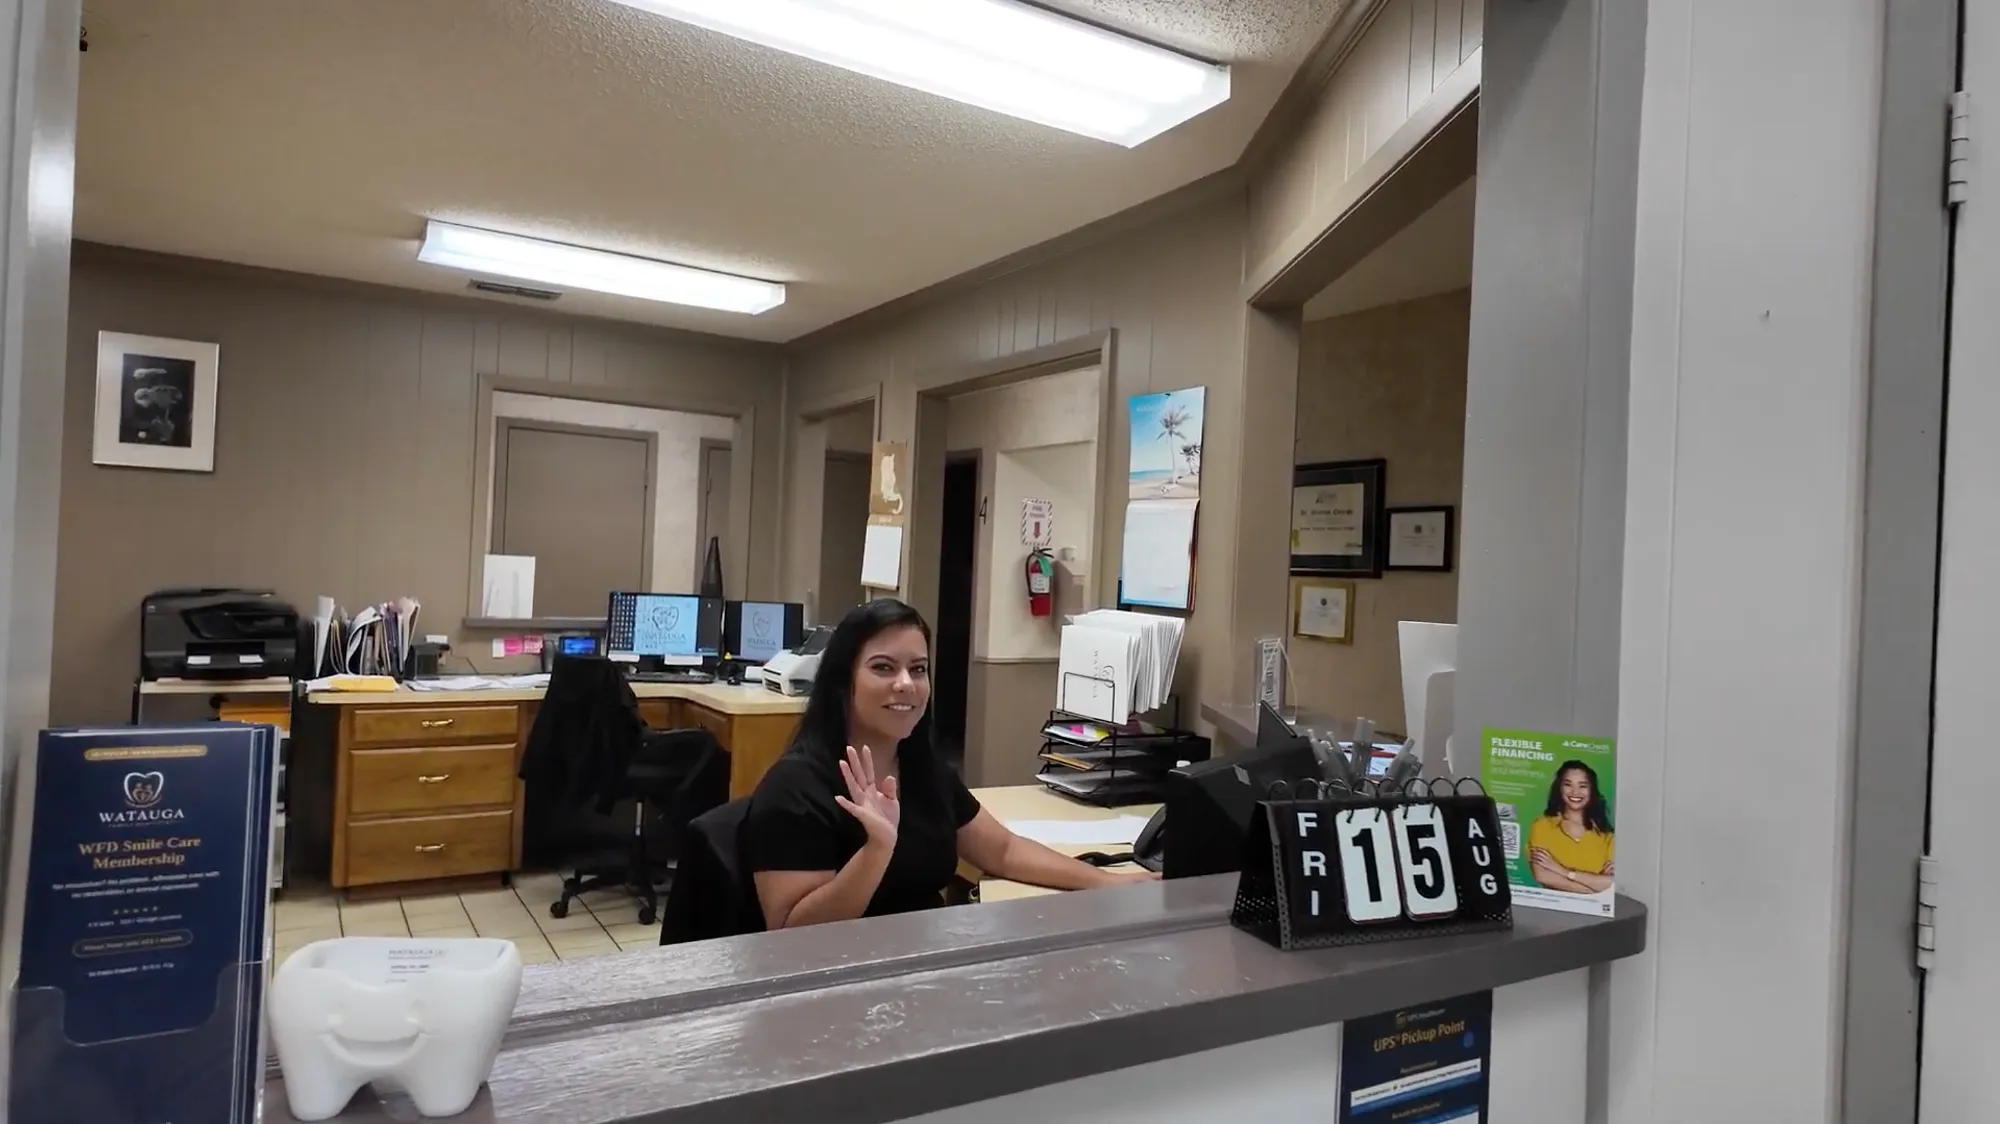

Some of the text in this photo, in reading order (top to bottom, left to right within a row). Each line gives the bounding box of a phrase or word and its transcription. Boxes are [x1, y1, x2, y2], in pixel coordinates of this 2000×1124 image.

[979, 496, 987, 525] 4
[1491, 737, 1543, 750] FLEXIBLE
[1491, 748, 1554, 761] FINANCING
[99, 808, 184, 823] WATAUGA
[78, 836, 201, 856] WFD Smile Care
[93, 852, 185, 870] Membership
[1352, 824, 1445, 902] 15
[1468, 818, 1498, 895] AUG
[1401, 1029, 1437, 1046] Pickup
[1438, 1020, 1466, 1037] Point
